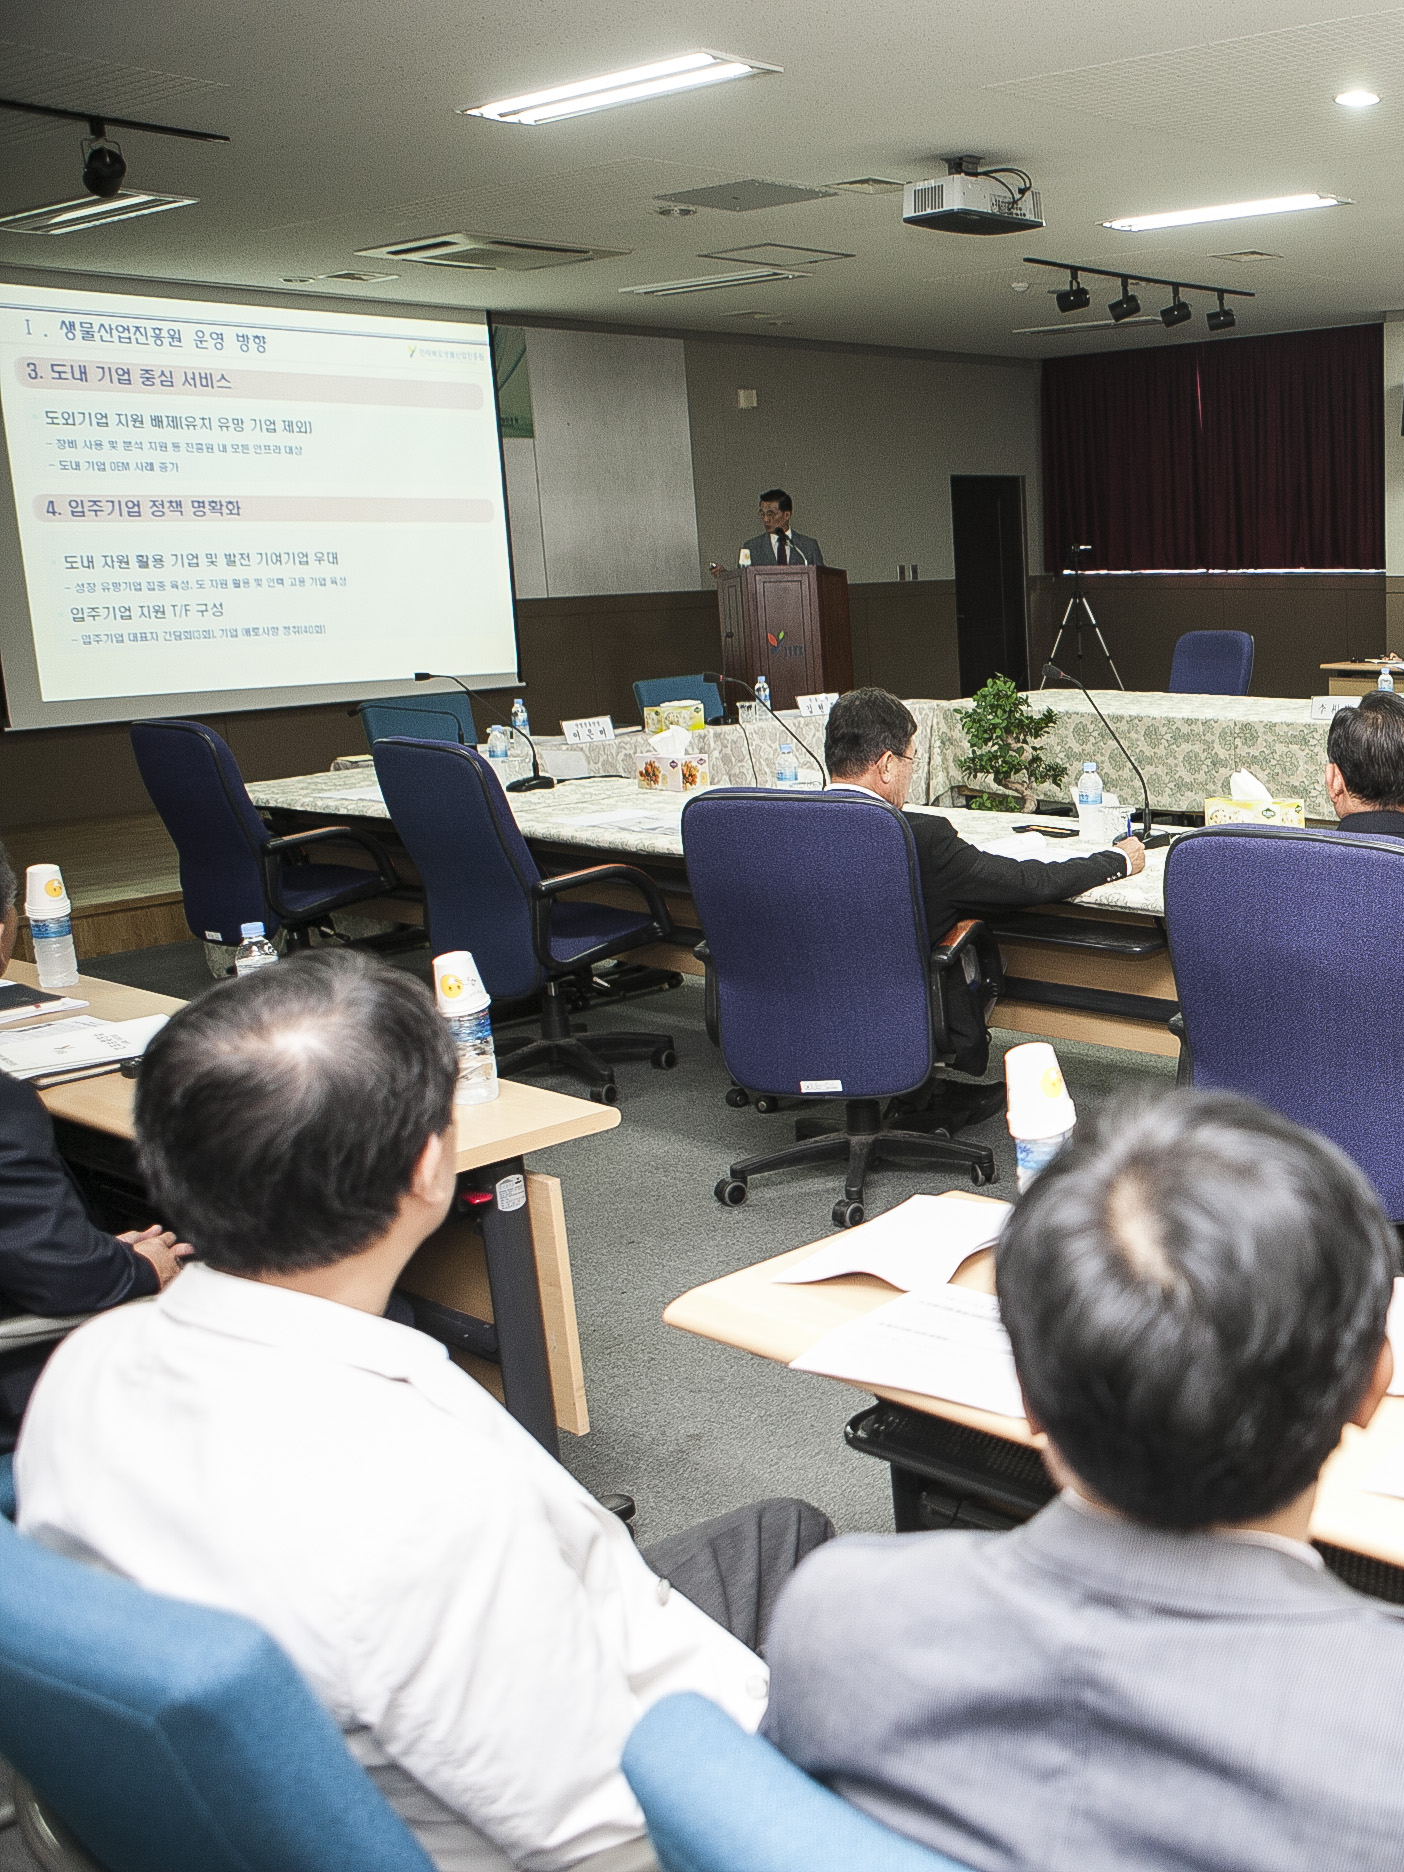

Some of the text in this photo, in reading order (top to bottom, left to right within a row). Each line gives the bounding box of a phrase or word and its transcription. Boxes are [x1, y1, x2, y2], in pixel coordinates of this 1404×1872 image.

[60, 319, 183, 348] 생물산업진흥원
[193, 329, 225, 350] 운영
[235, 332, 267, 353] 방향
[26, 362, 232, 390] 3. 도내 기업 중심 서비스
[44, 410, 109, 428] 도외기업
[115, 412, 145, 430] 지원
[218, 416, 244, 433] 유망
[250, 417, 277, 434] 기업
[46, 499, 241, 518] 4. 입주기업 정책 명확화
[64, 551, 339, 570] 도내 자원 활용 기업 및 발전 기여기업 우대
[70, 602, 224, 622] 입주기업 지원 T/F 구성
